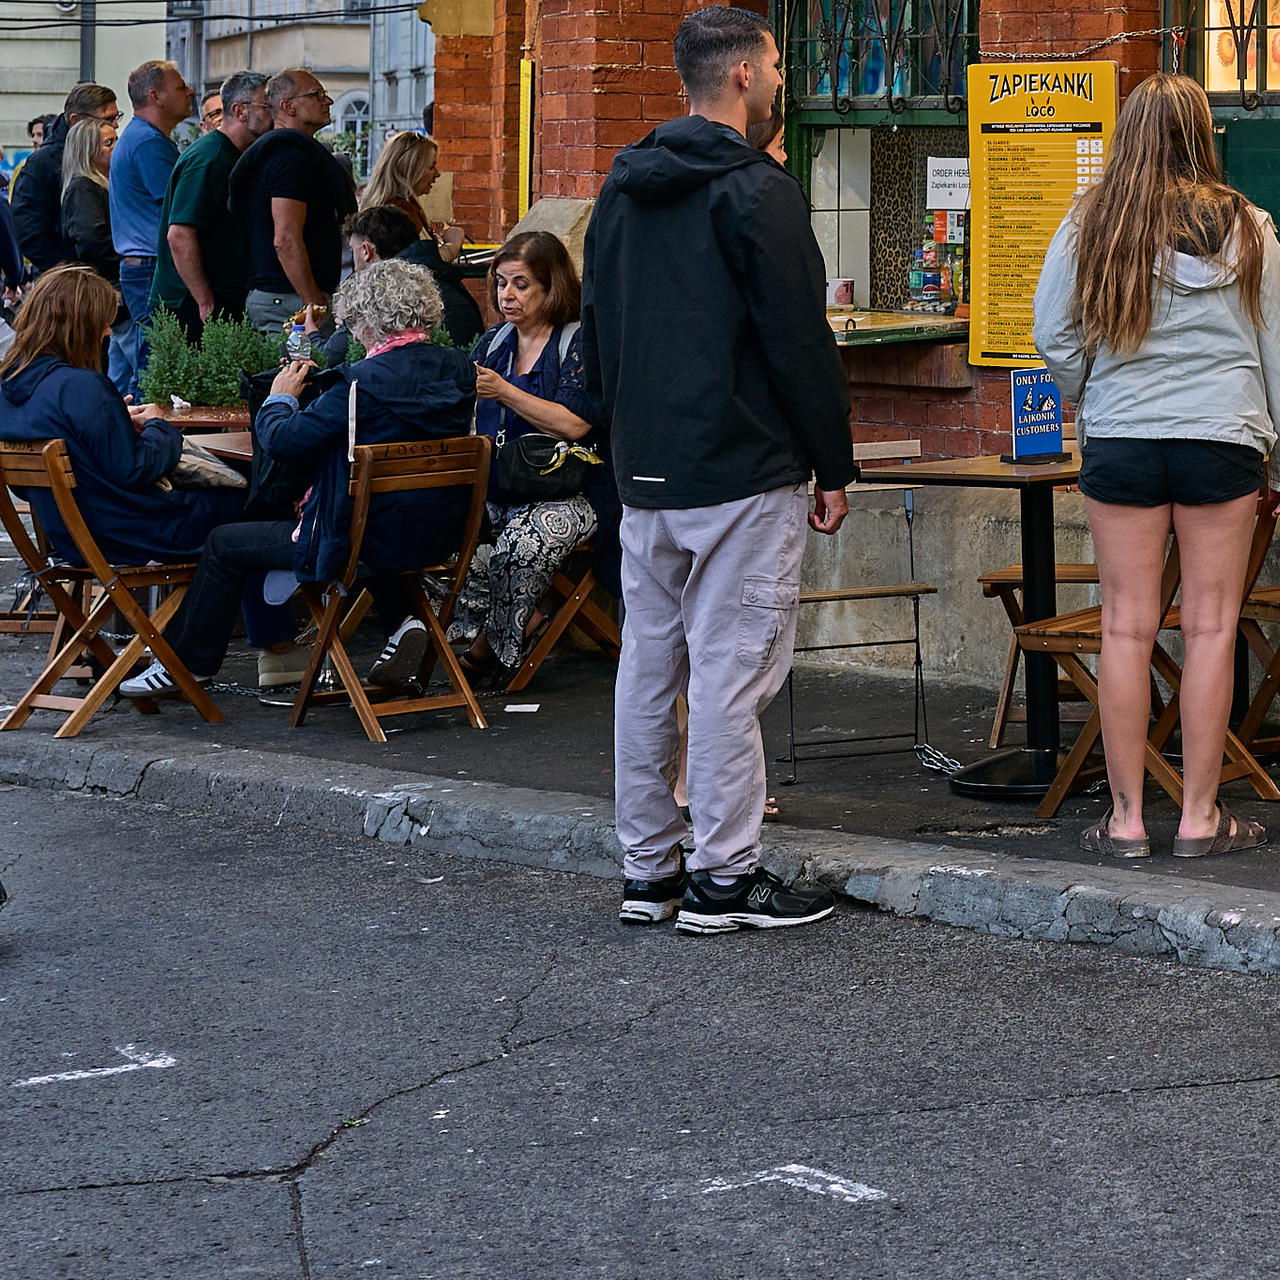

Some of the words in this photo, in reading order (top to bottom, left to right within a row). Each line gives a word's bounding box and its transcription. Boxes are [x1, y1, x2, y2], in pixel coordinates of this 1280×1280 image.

[989, 73, 1093, 104] ZAPIEKANKI
[1025, 106, 1056, 118] LOCO
[932, 168, 953, 178] ORDER
[1016, 374, 1037, 386] ONLY
[1018, 411, 1056, 424] LAJKONIK
[1016, 423, 1060, 436] CUSTOMERS
